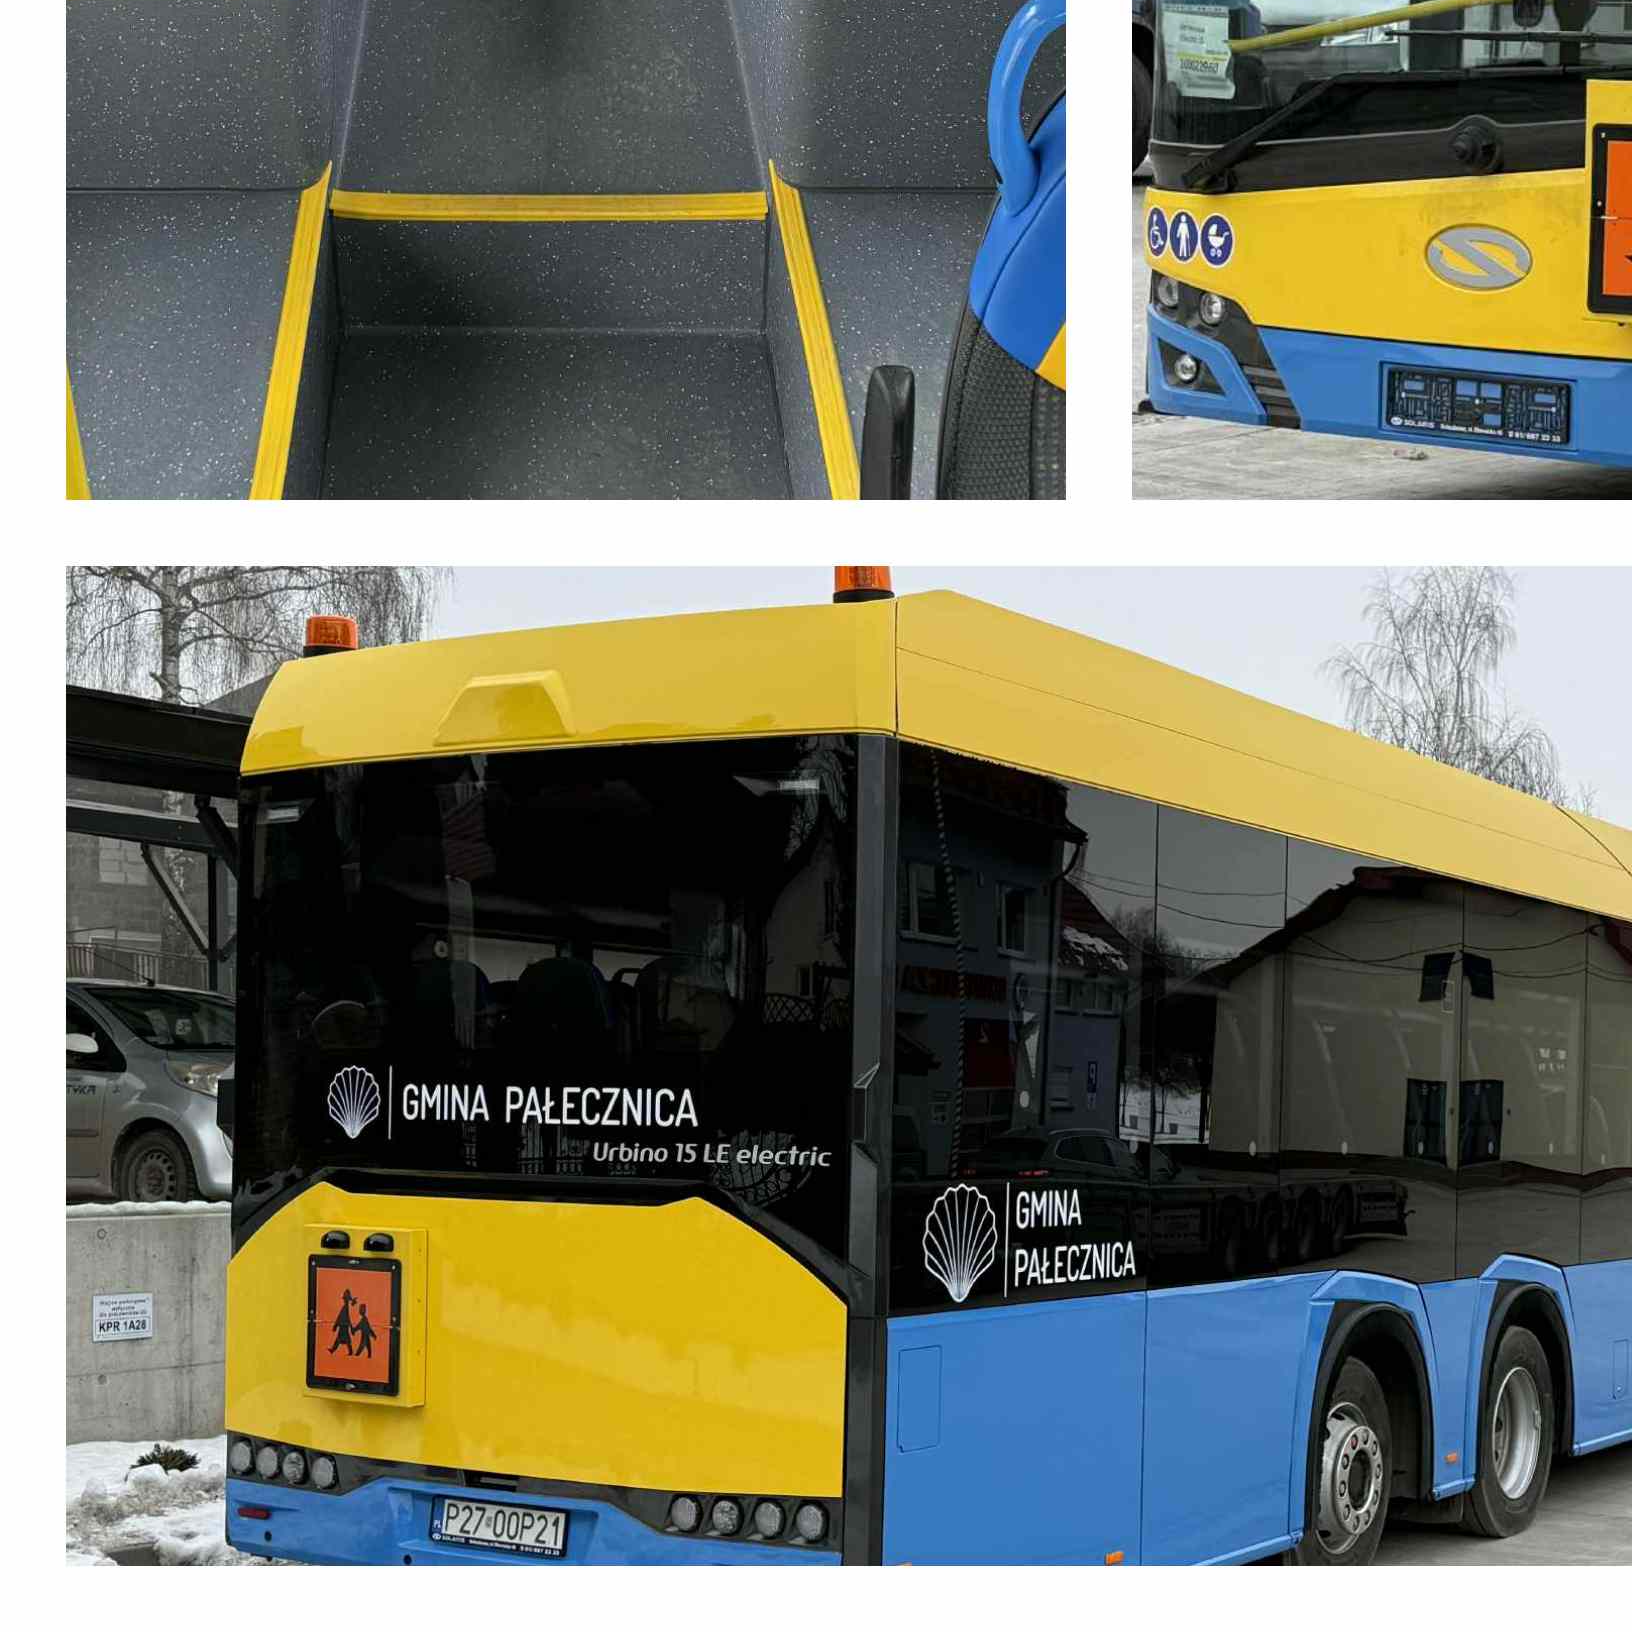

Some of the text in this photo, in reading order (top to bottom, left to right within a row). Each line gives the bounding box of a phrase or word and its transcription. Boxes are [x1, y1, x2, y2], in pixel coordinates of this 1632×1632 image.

[402, 1083, 699, 1128] GMINA PAŁECZNICA
[592, 1141, 833, 1168] Urbino 15 LE electric
[1015, 1188, 1083, 1230] GMINA
[1014, 1240, 1137, 1288] PAŁECZNICA
[99, 1320, 121, 1334] KPR
[445, 1502, 560, 1546] P27 00P21
